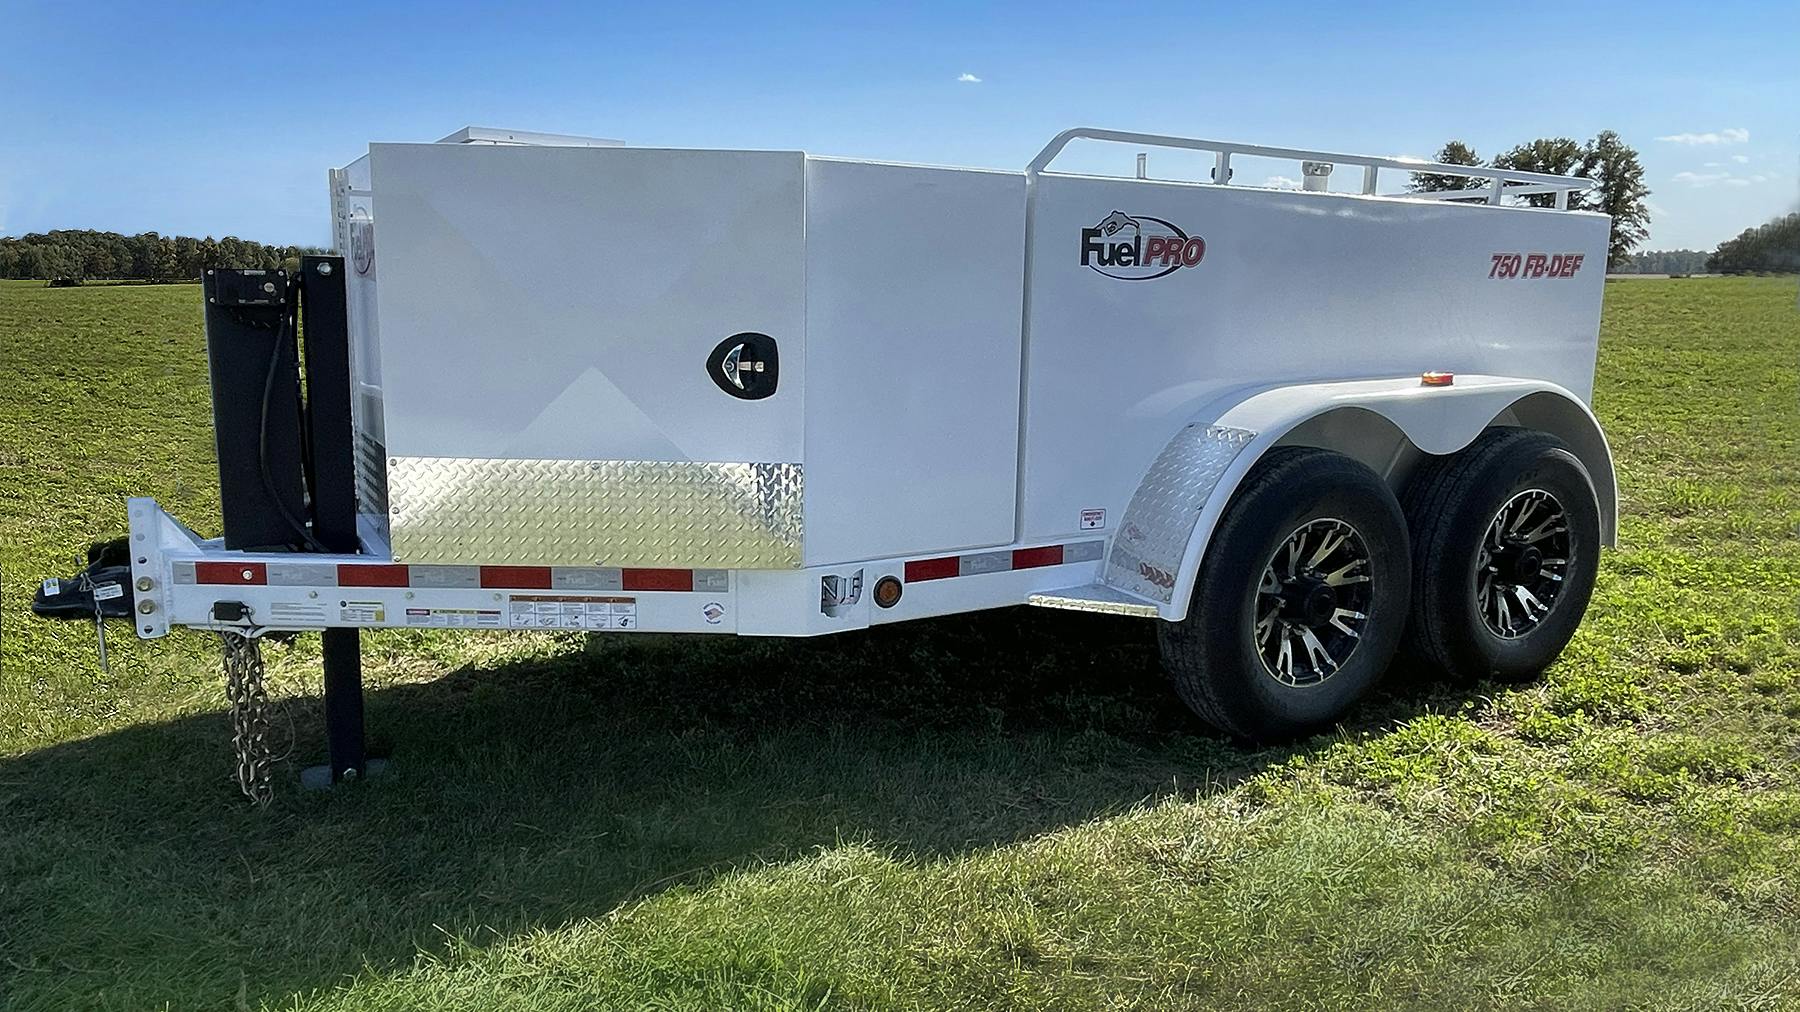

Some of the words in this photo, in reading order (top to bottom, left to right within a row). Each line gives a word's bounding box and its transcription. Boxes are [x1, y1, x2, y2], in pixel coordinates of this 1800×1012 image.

[1080, 227, 1141, 267] Fuel
[1141, 235, 1206, 268] PRO
[1488, 252, 1522, 280] 750
